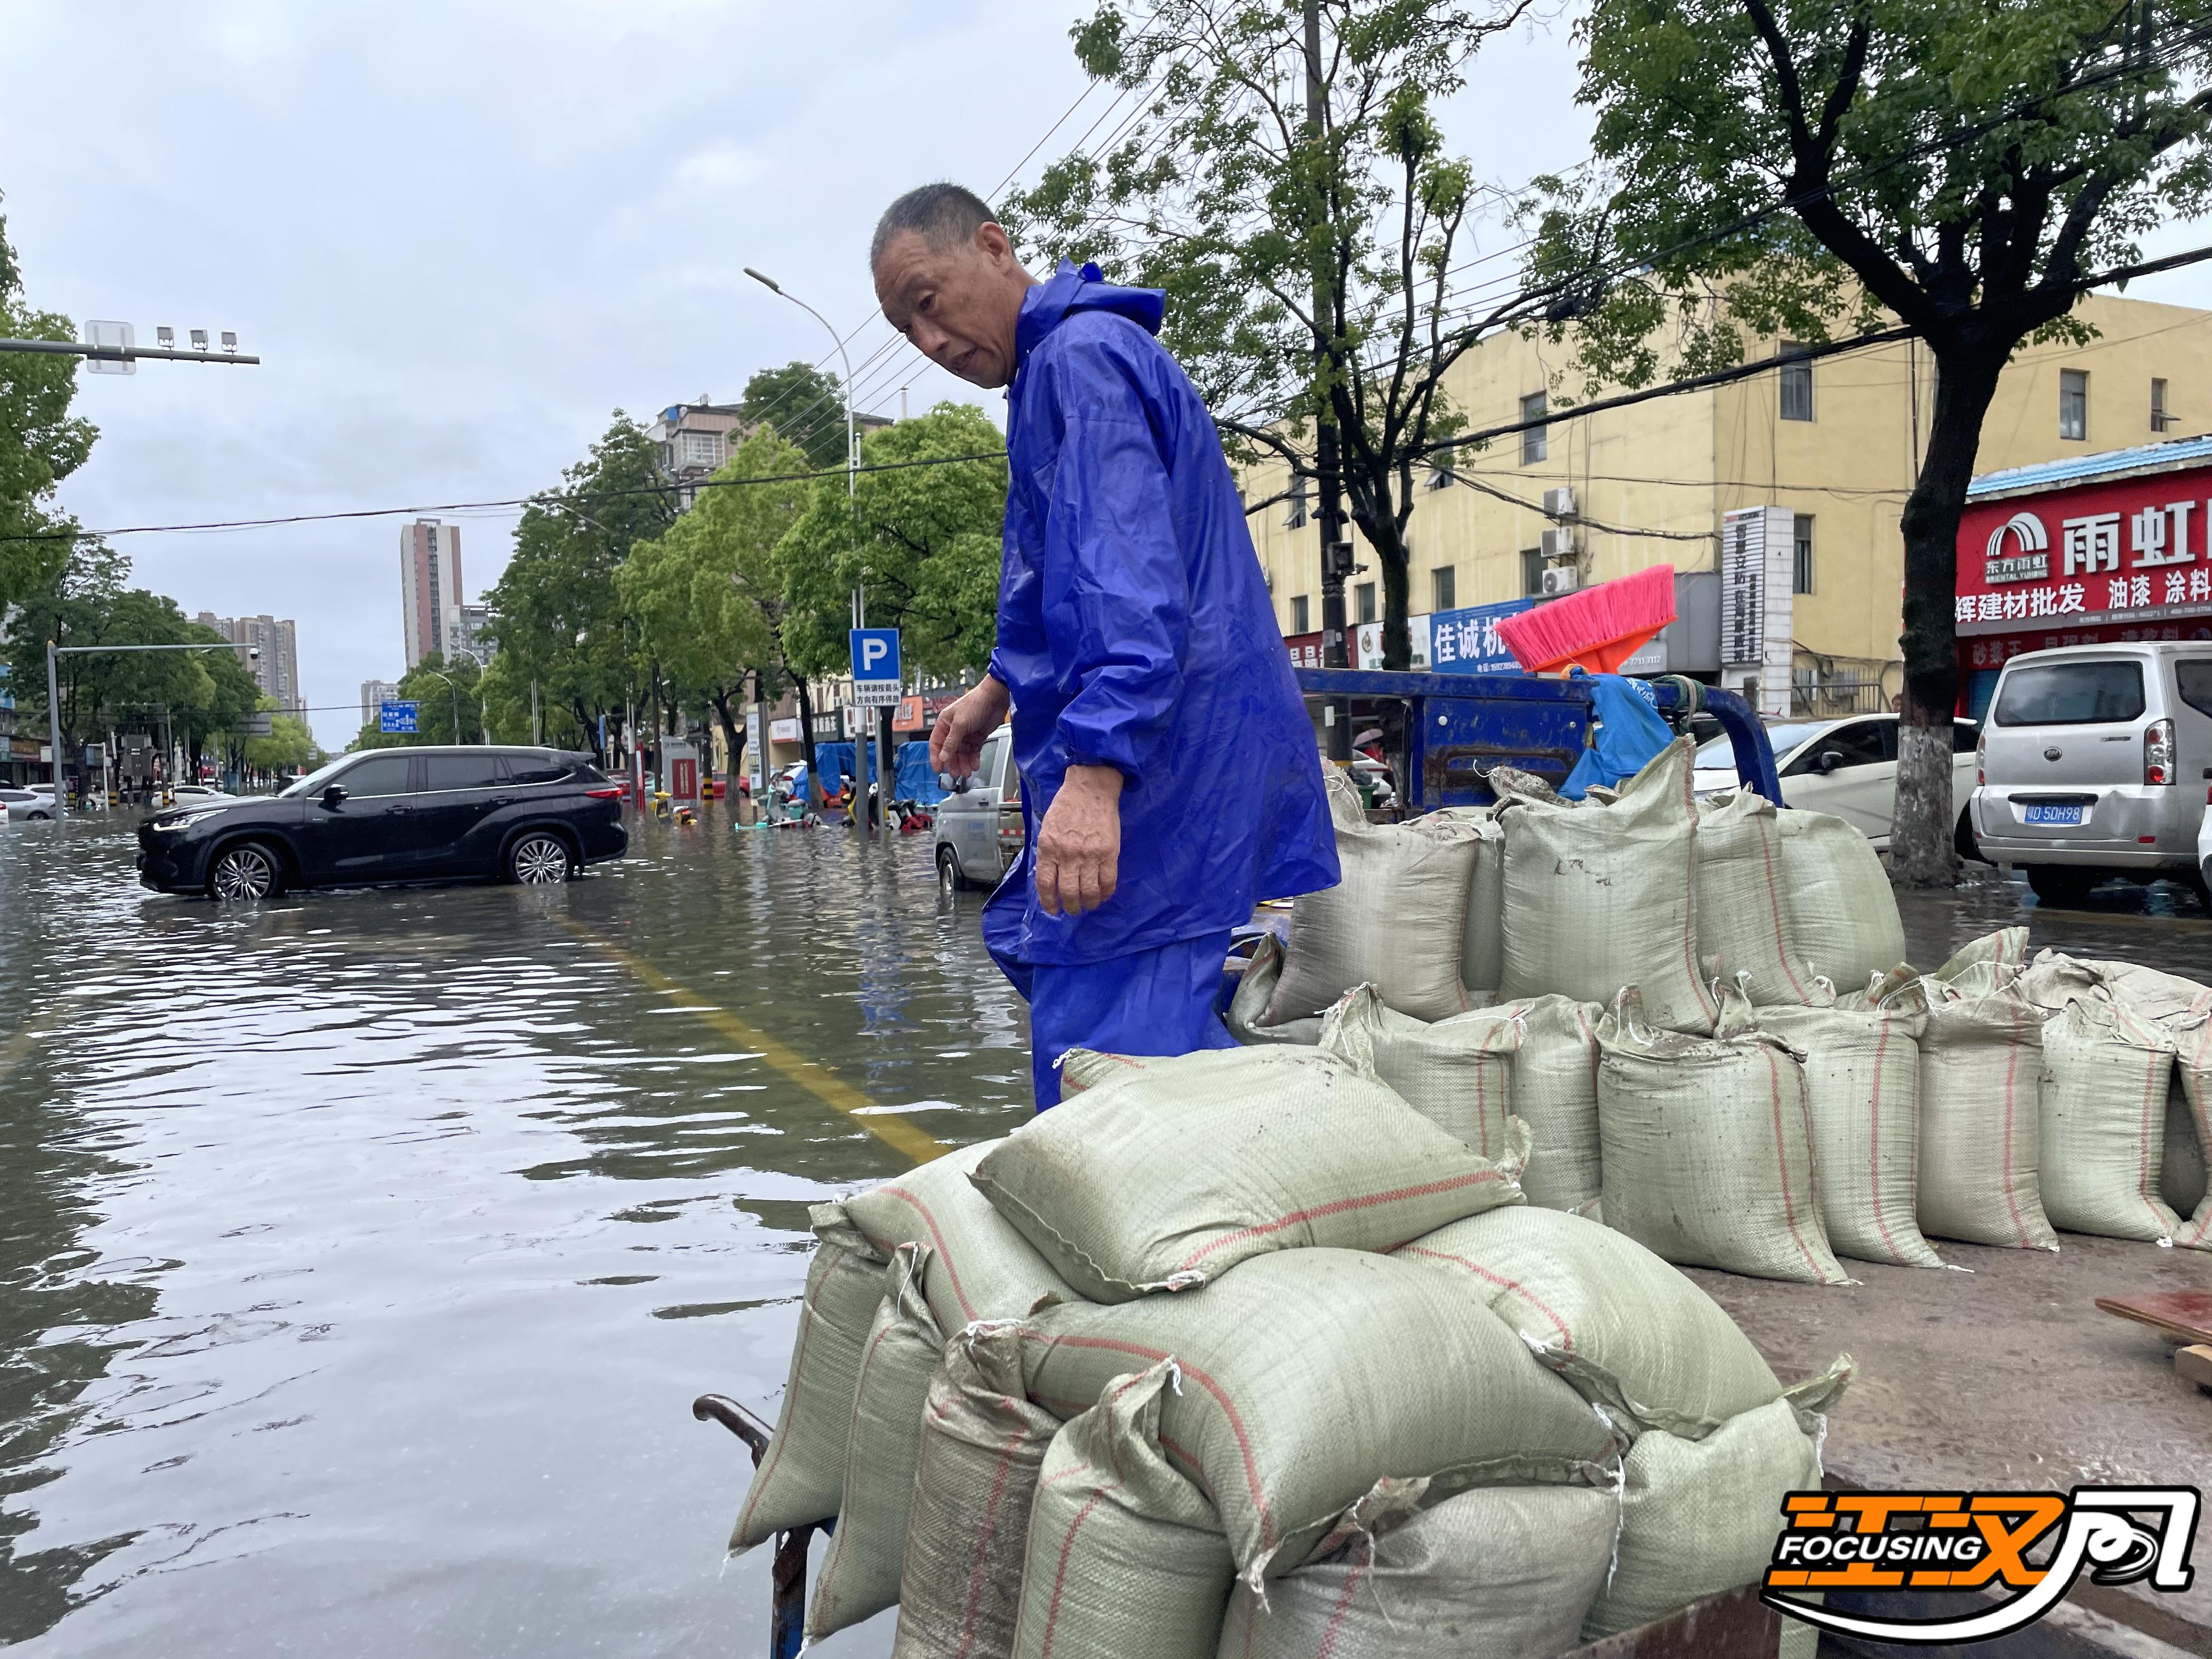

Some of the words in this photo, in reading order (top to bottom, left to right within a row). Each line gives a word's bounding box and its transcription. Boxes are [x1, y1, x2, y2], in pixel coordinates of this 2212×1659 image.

[2063, 500, 2212, 576] 雨虹
[1986, 554, 2047, 574] 东方雨虹
[2108, 574, 2151, 609] 油漆
[2165, 567, 2212, 604] 涂料
[863, 638, 888, 670] P
[1434, 612, 1517, 664] 佳诚机
[856, 684, 900, 693] 车辆请按箭头
[857, 695, 900, 704] 方向有序停放
